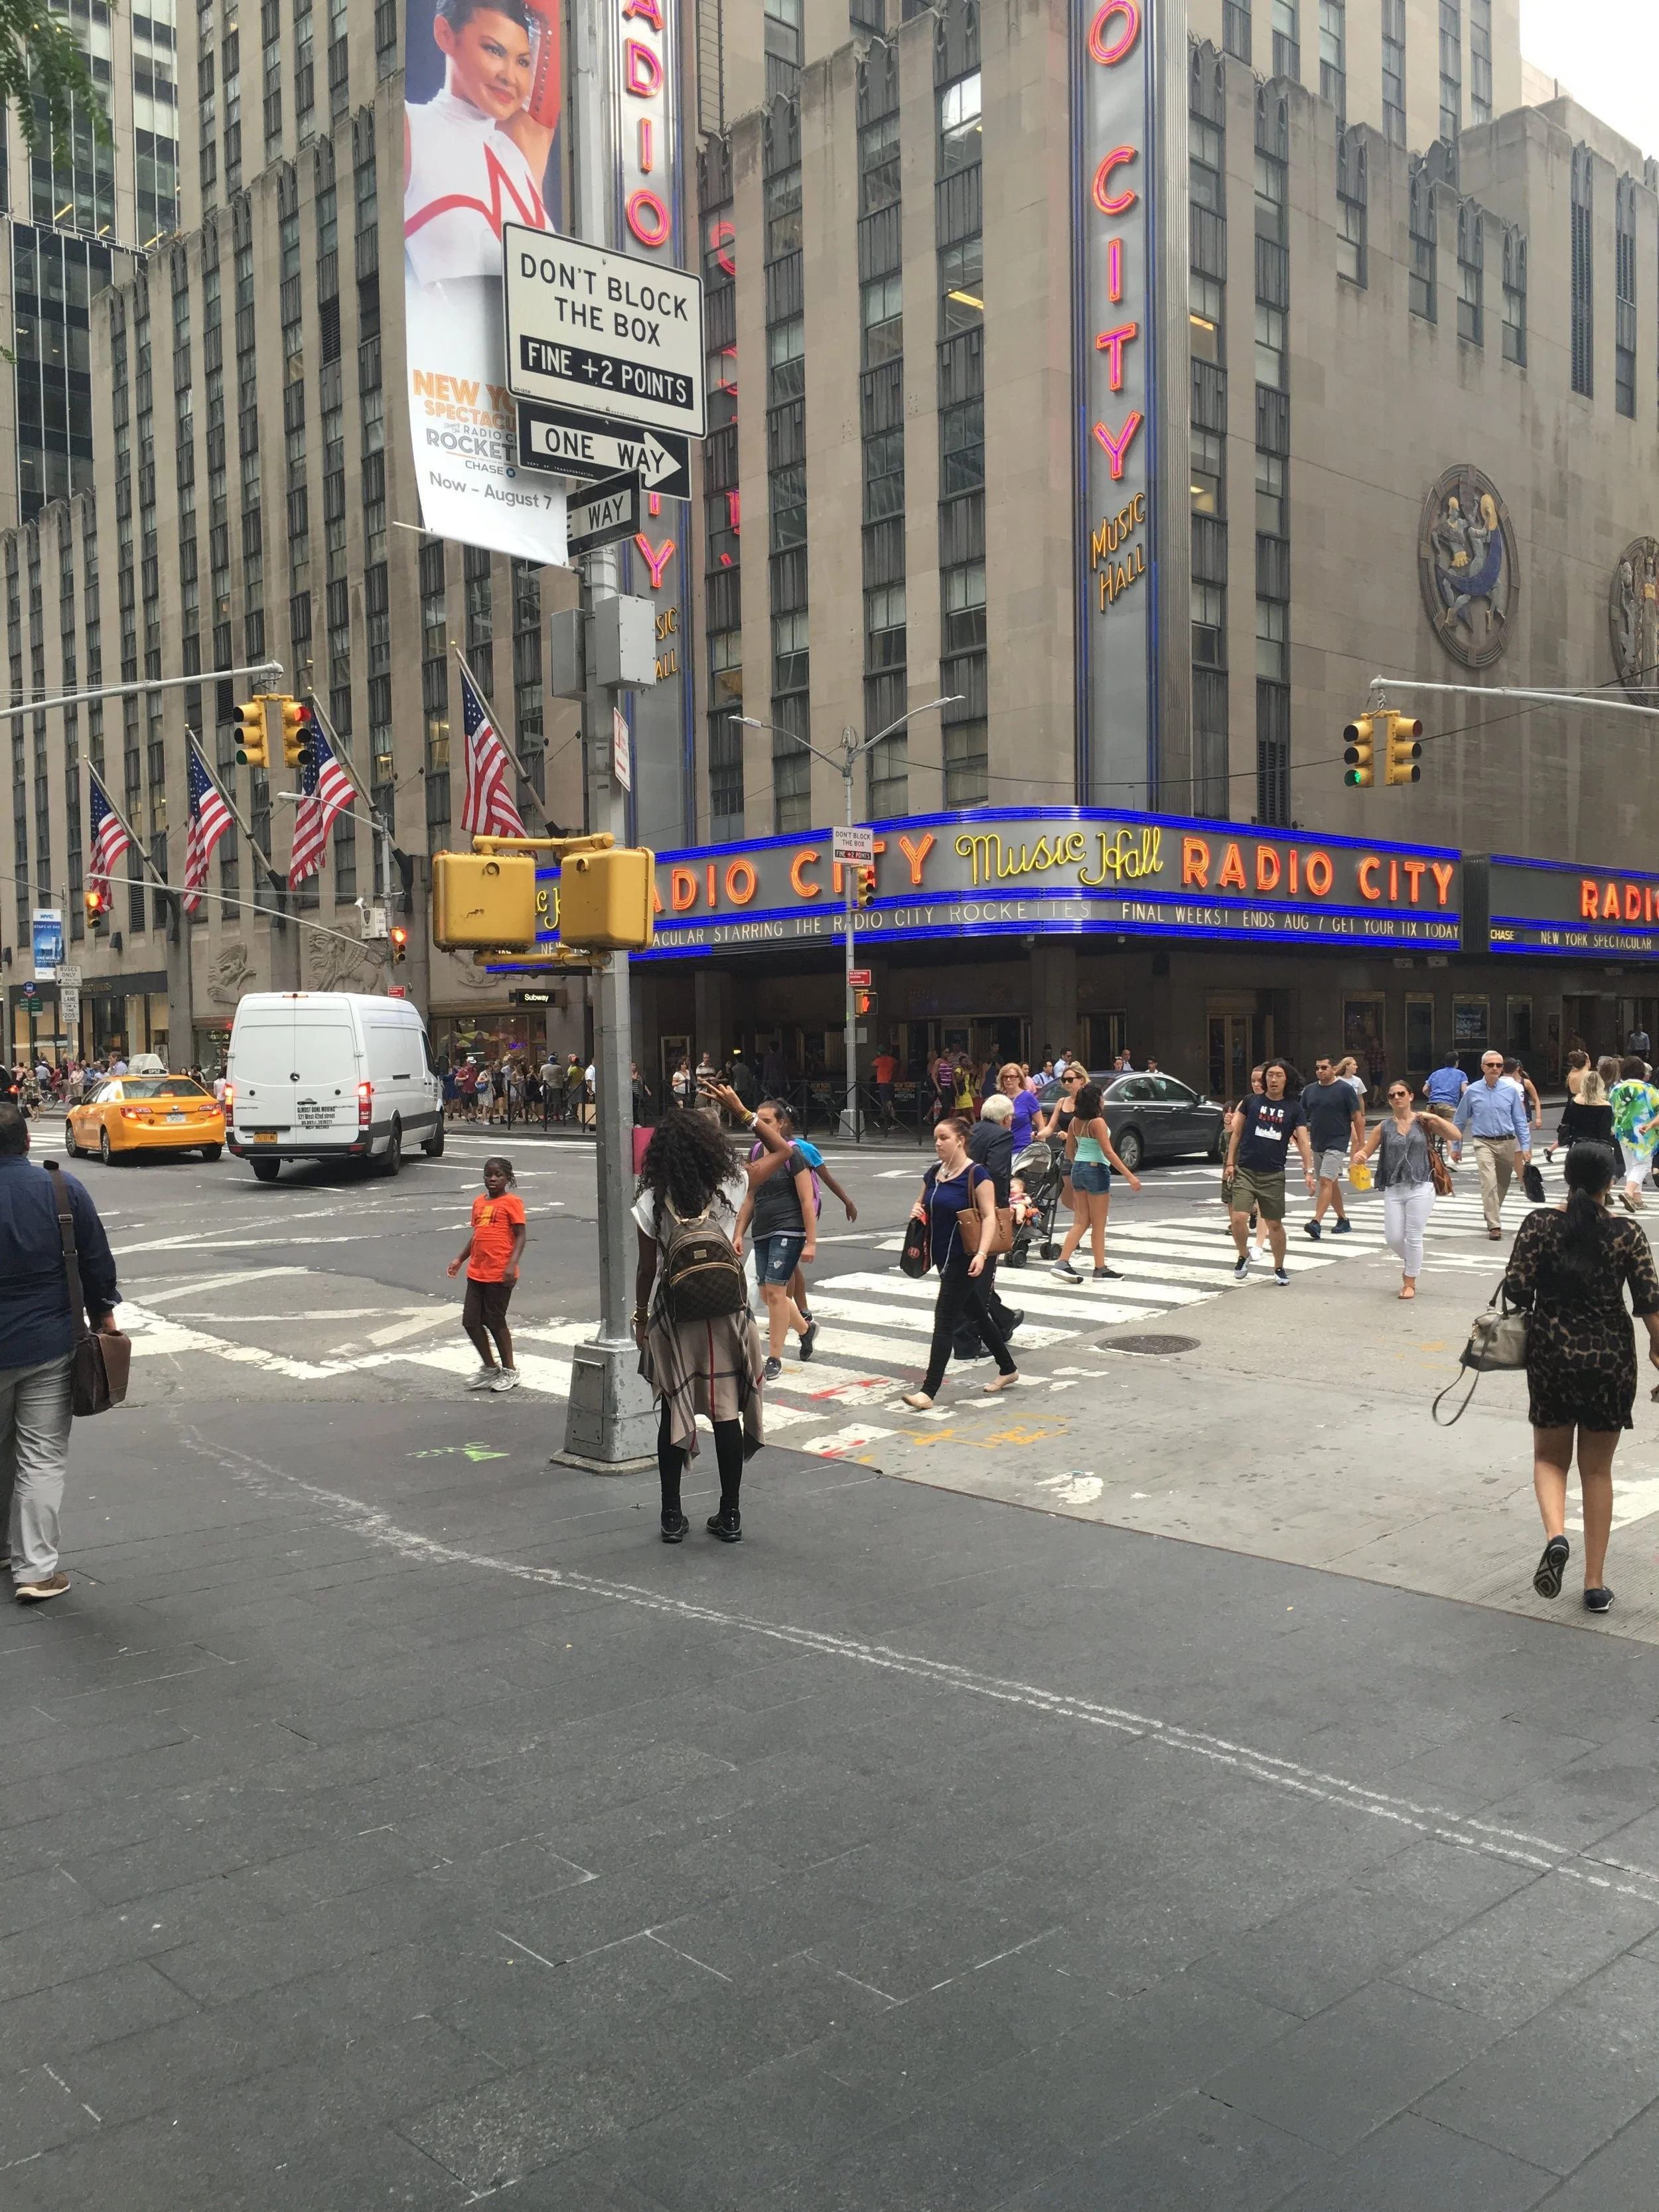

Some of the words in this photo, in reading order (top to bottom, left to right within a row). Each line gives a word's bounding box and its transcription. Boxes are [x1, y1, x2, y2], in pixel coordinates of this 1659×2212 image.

[521, 252, 597, 295] DON'T
[607, 276, 687, 321] BLOCK
[554, 296, 604, 332] THE
[614, 312, 660, 347] BOX
[1092, 145, 1143, 481] CITY
[413, 369, 480, 407] NEW
[528, 341, 573, 376] FINE
[581, 358, 614, 386] +2
[621, 364, 686, 403] POINTS
[424, 400, 516, 432] SPECTACU
[463, 425, 502, 441] RADIO
[465, 461, 504, 475] CHASE
[545, 427, 595, 460] ONE
[617, 442, 665, 474] WAY
[429, 471, 467, 492] Now
[484, 484, 539, 507] August
[544, 495, 552, 510] 7
[588, 495, 624, 530] WAY
[1093, 493, 1145, 571] MUSIC
[1100, 543, 1146, 614] HALL
[955, 832, 1086, 885] Music
[1078, 827, 1163, 885] Hall
[1183, 837, 1333, 896] RADIO
[1358, 856, 1454, 905] CITY
[1581, 880, 1659, 921] RADI
[714, 921, 783, 942] STARRING
[796, 917, 822, 934] THE
[895, 907, 934, 926] CITY
[949, 901, 1090, 922] ROCKETTES
[1121, 902, 1165, 922] FINAL
[1175, 907, 1228, 925] WEEKS!
[1243, 911, 1275, 928] ENDS
[1284, 914, 1309, 930] AUG
[1319, 917, 1325, 930] 7
[1333, 917, 1356, 933] GET
[1364, 919, 1394, 935] YOUR
[1400, 921, 1417, 936] TIX
[1425, 922, 1459, 938] TODAY
[1490, 929, 1515, 940] CHASE
[1541, 931, 1559, 944] NEW
[1565, 932, 1588, 946] YORK
[1593, 934, 1652, 950] SPECTACULAR
[524, 994, 549, 1003] Subway
[1260, 1105, 1285, 1118] NYC
